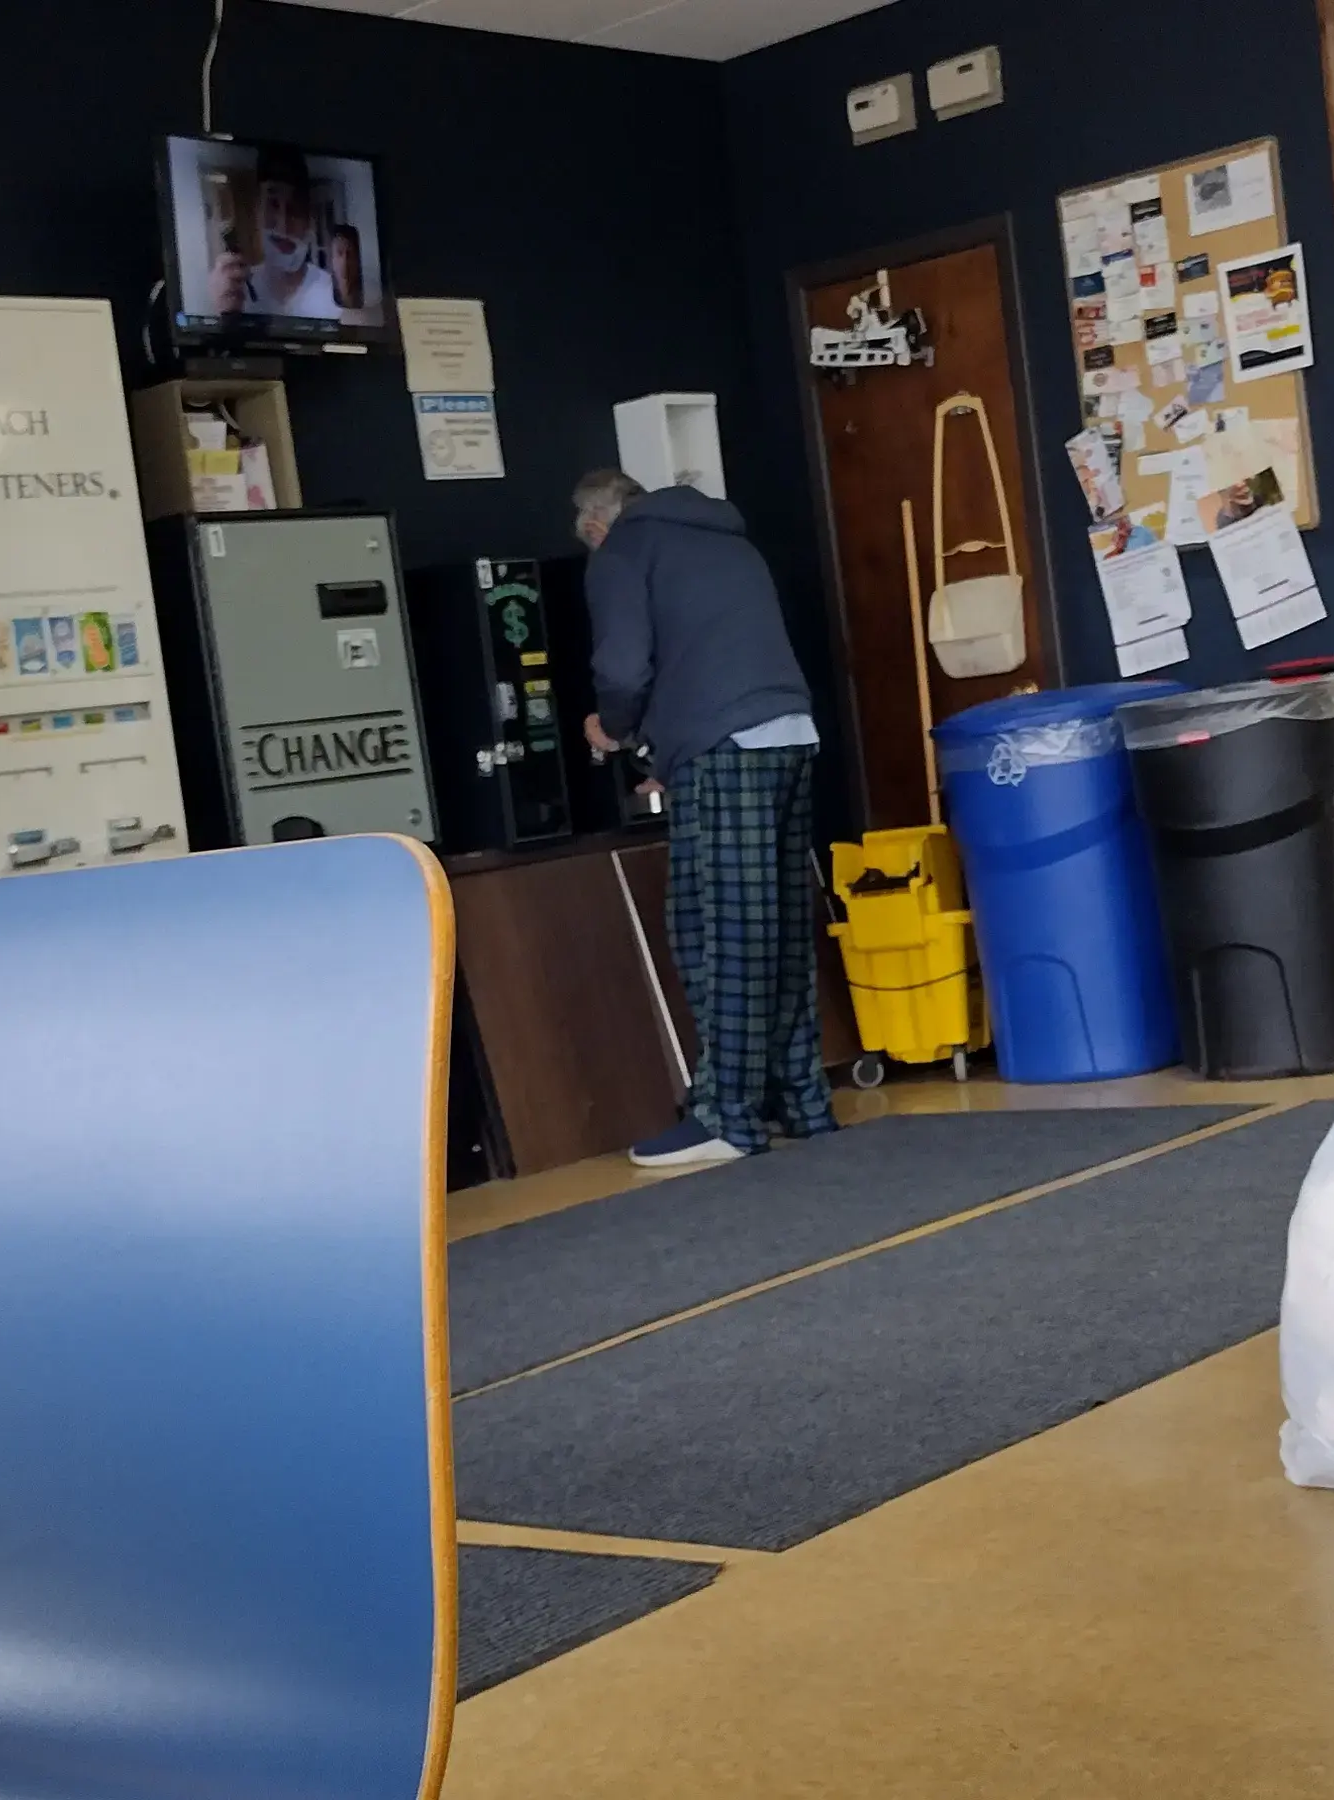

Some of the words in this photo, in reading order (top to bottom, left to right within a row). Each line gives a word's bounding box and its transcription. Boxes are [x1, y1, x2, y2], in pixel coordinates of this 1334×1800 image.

[420, 397, 488, 412] Please
[502, 599, 529, 648] $
[256, 724, 398, 778] CHANGE
